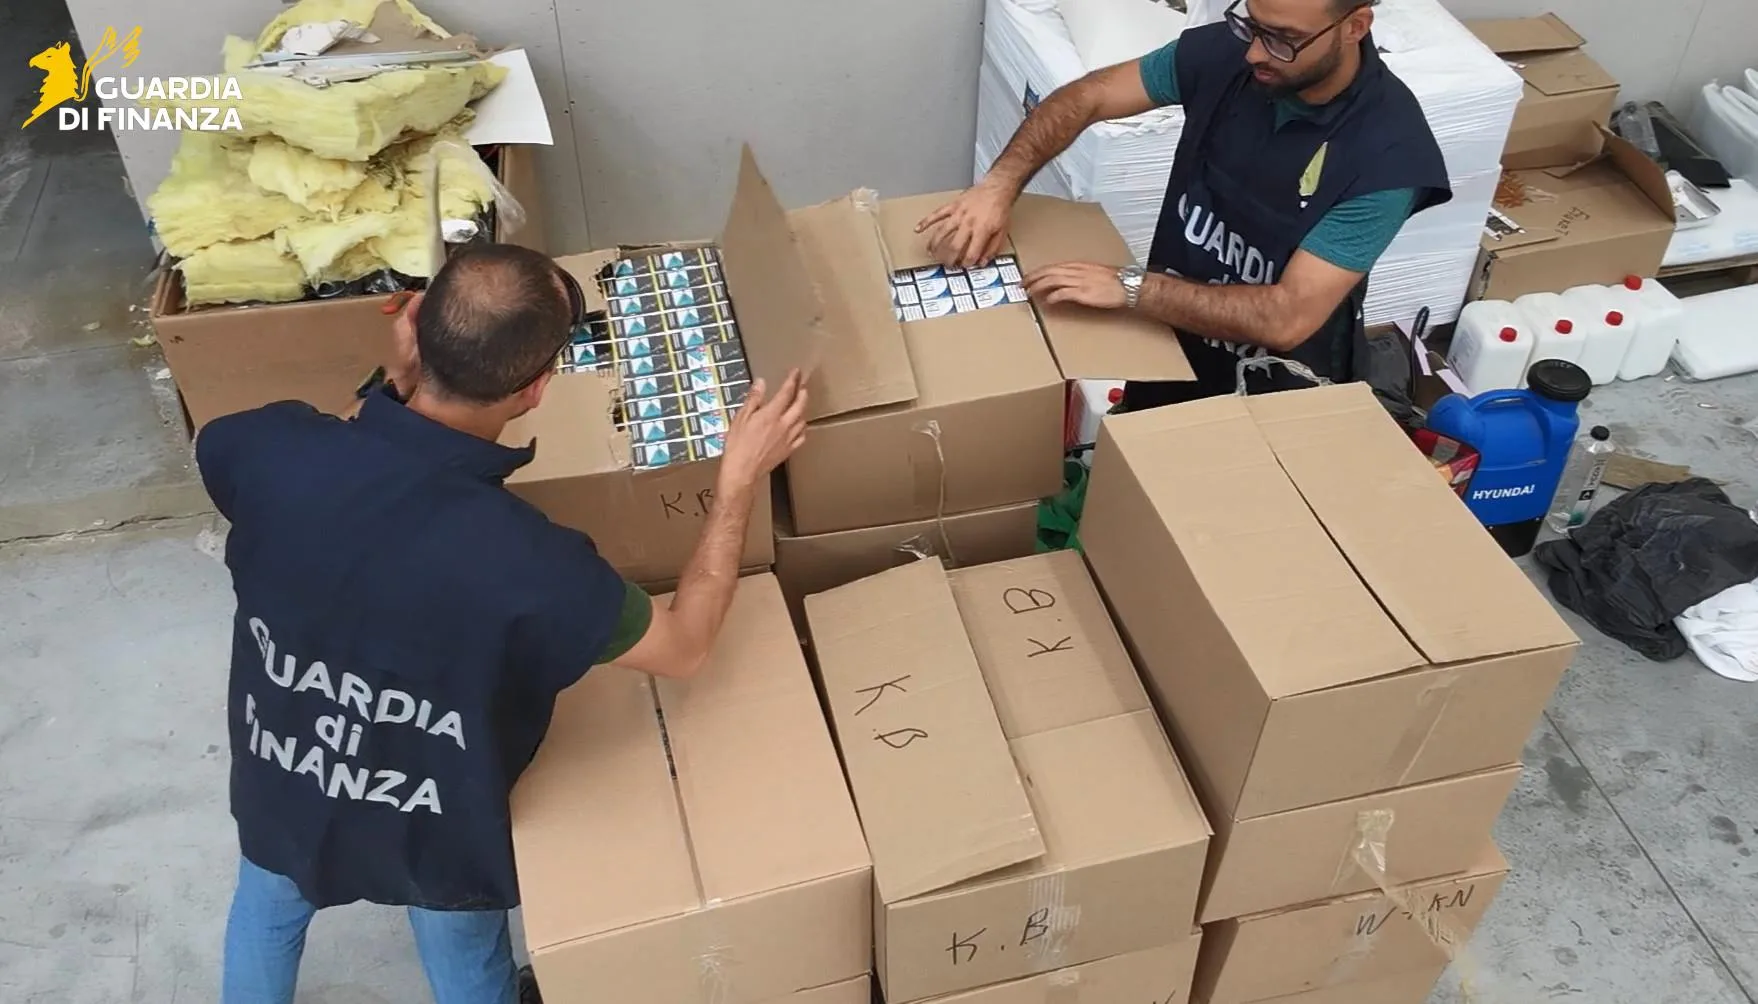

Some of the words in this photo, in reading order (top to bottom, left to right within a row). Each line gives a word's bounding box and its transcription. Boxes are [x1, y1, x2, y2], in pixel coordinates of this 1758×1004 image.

[1178, 192, 1275, 285] UARDI
[1473, 484, 1535, 500] HYUNDAI
[314, 714, 364, 758] di
